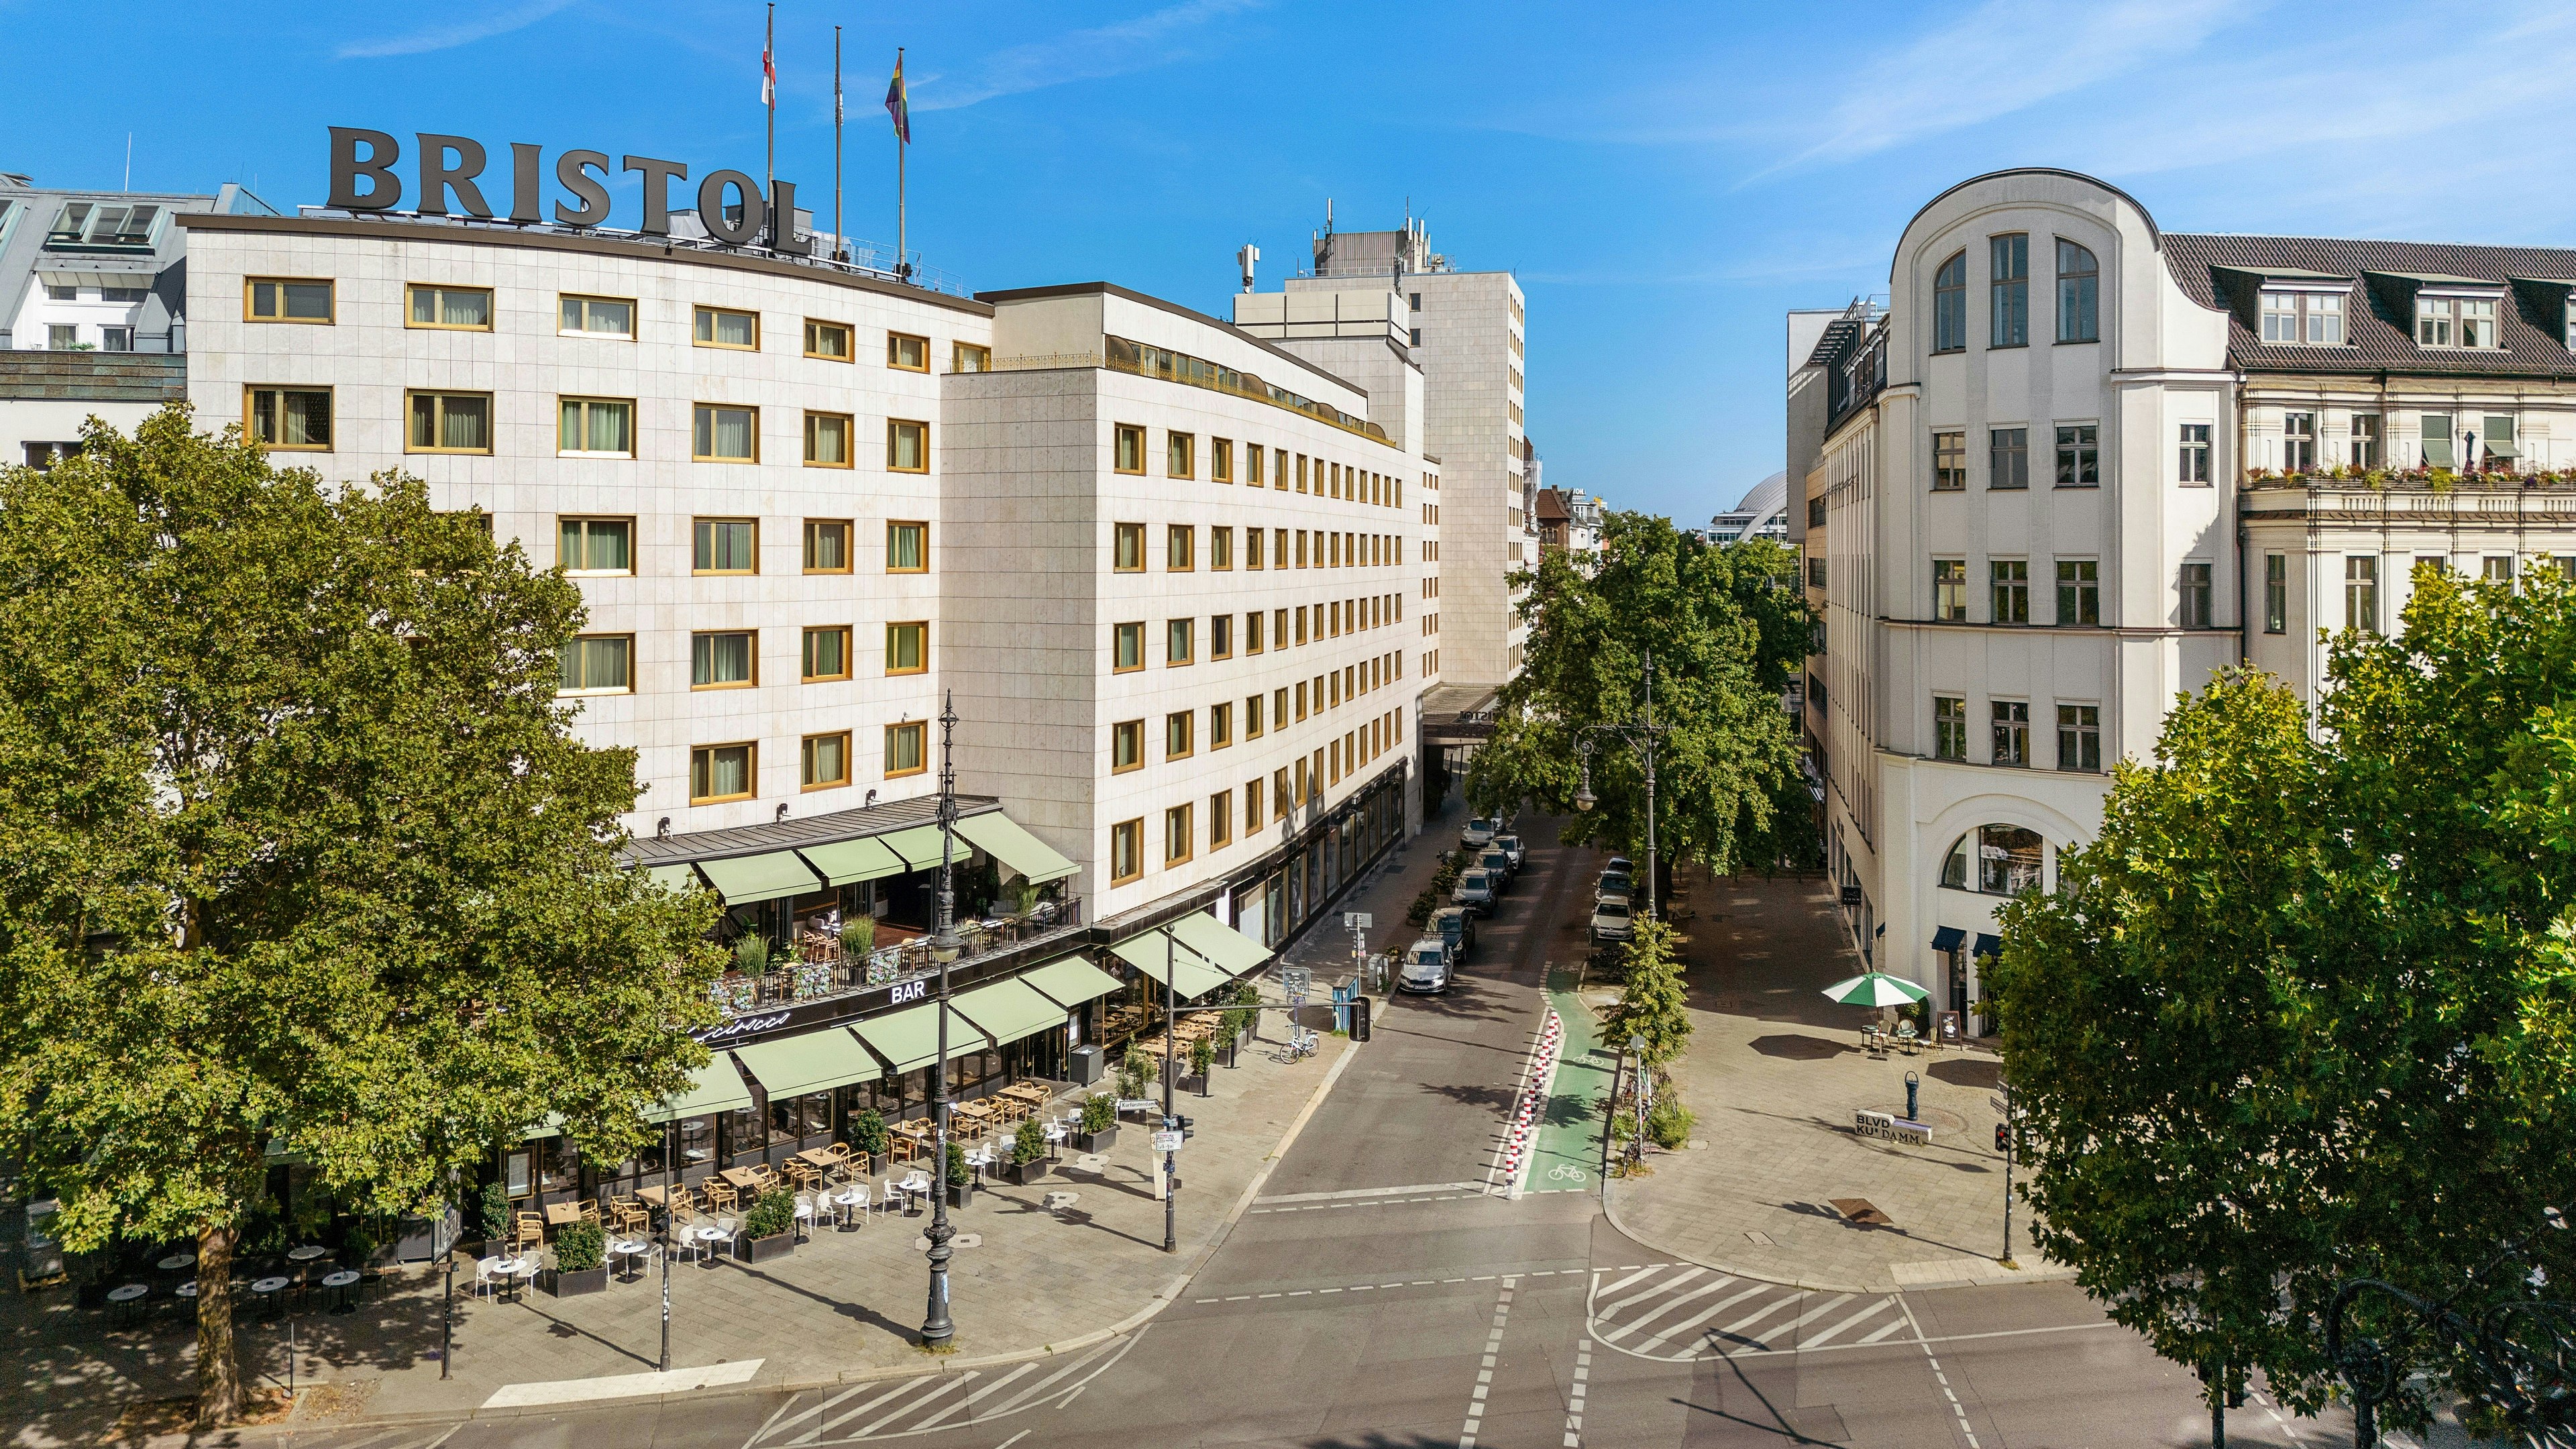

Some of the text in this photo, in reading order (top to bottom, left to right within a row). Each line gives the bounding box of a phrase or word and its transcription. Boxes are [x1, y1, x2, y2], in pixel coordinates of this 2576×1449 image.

[325, 125, 812, 256] BRISTOL
[892, 981, 925, 1004] BAR
[1856, 1114, 1890, 1128] BLVD
